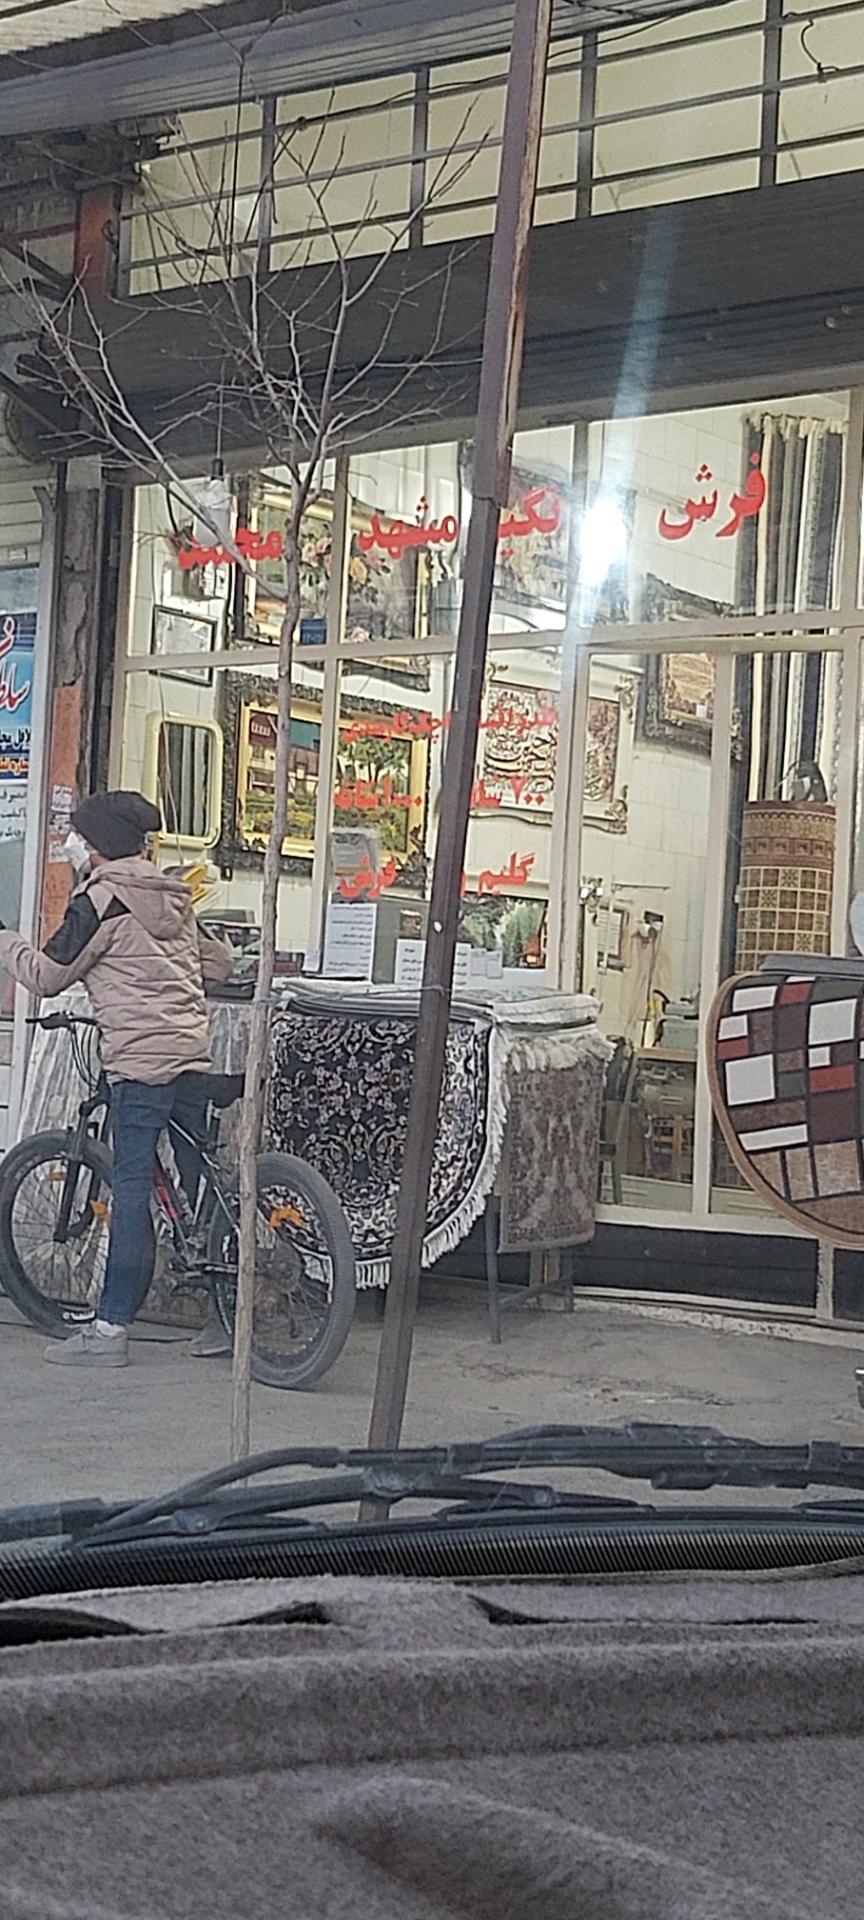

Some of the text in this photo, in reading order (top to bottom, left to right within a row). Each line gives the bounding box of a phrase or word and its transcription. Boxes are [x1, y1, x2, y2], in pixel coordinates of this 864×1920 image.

[496, 481, 563, 557] نگی
[657, 452, 768, 540] فرش
[356, 496, 459, 560] مشهد
[509, 774, 546, 805] ۷۰۰
[338, 852, 399, 898] فرش
[478, 852, 536, 897] گلیم
